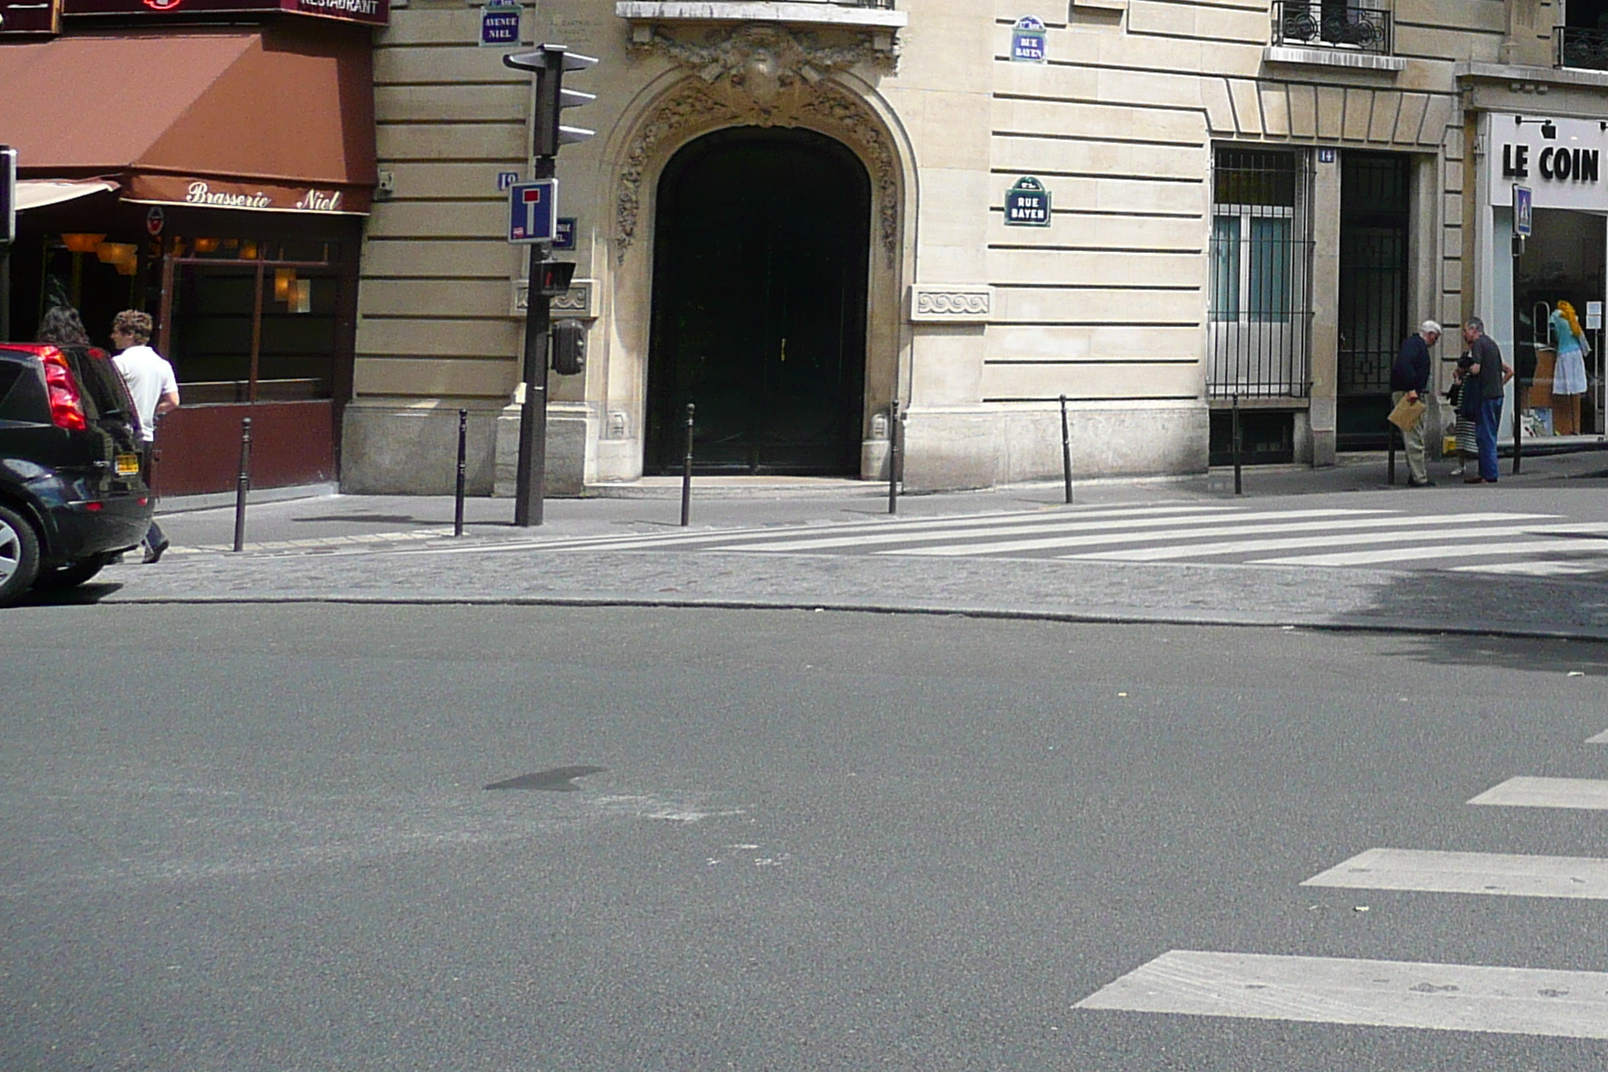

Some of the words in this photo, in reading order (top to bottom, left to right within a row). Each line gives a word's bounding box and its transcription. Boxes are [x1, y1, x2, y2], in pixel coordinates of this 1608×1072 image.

[485, 18, 517, 27] AVENUE
[489, 29, 512, 38] NIEL
[1321, 150, 1332, 162] 14
[1503, 144, 1529, 178] LE
[1539, 147, 1598, 182] COIN
[186, 182, 271, 209] Brasserie
[296, 188, 341, 211] Niel
[1017, 196, 1039, 208] RUE
[1011, 208, 1045, 219] BAYEN
